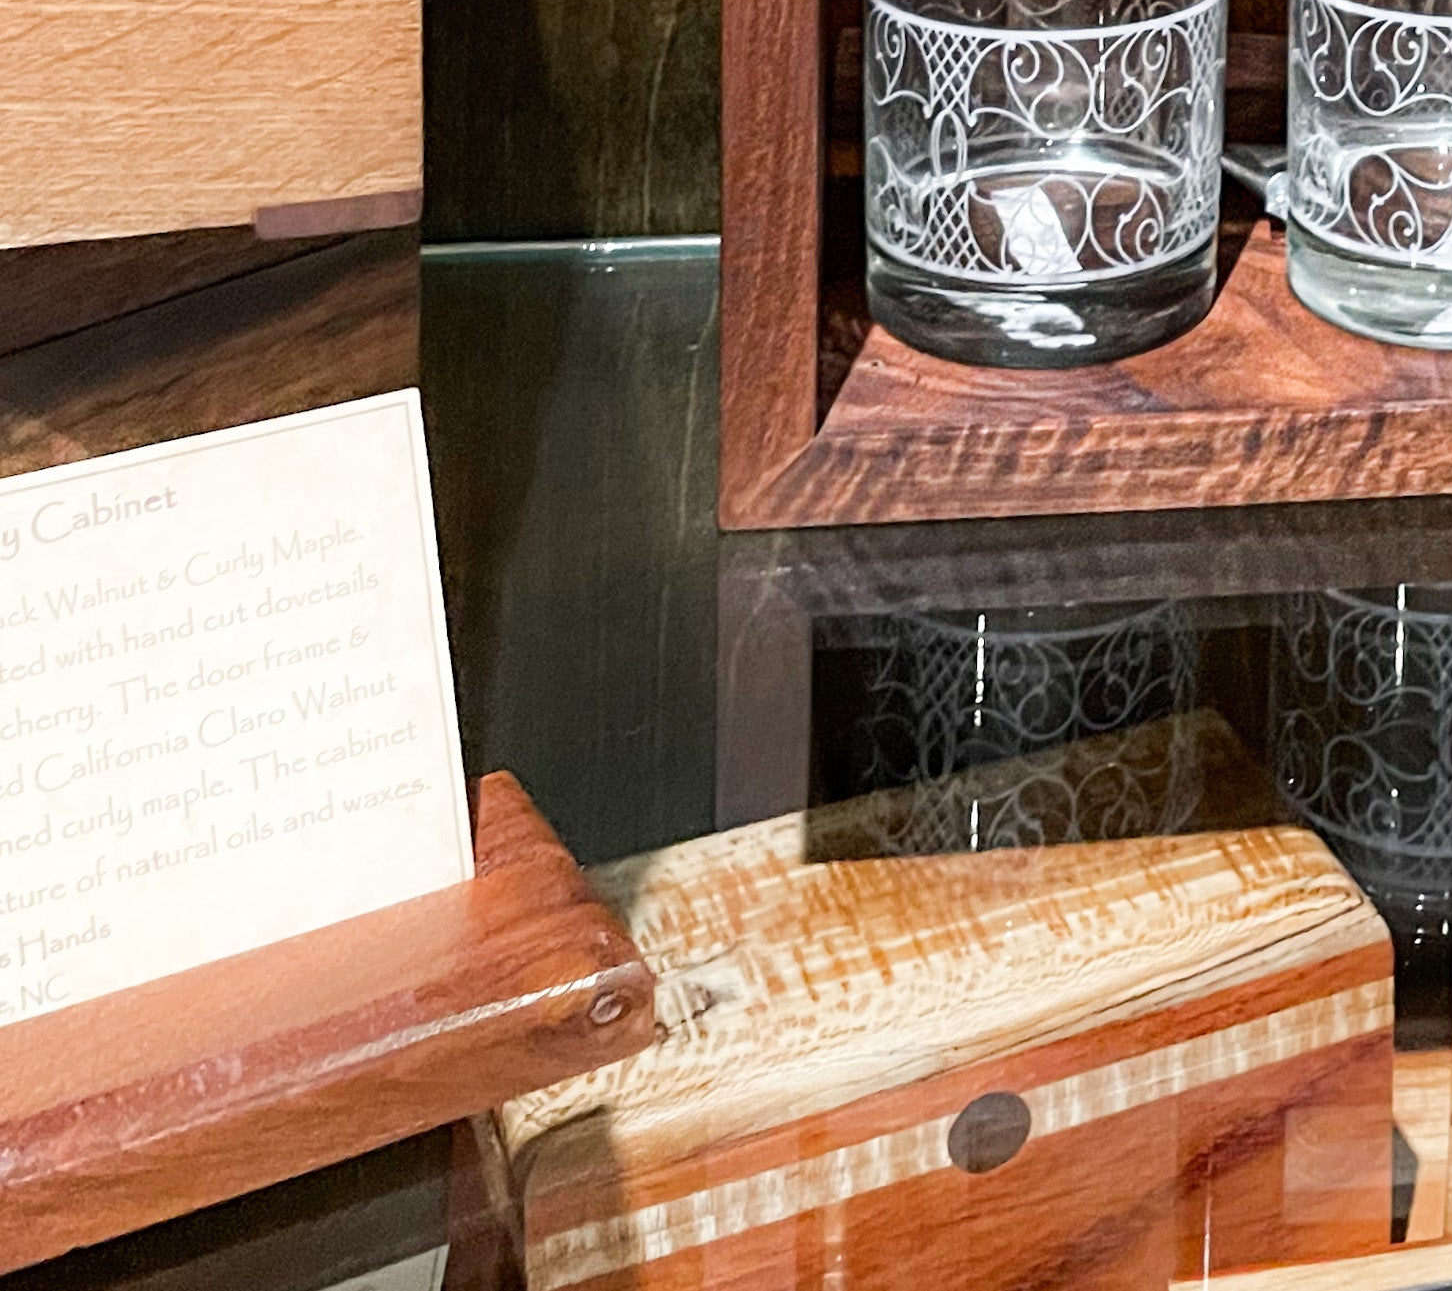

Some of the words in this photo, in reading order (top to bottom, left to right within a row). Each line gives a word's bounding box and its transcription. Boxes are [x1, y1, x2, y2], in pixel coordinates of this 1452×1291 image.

[31, 486, 177, 543] Cabinet
[43, 576, 148, 621] Walnut
[156, 569, 177, 591] &
[184, 542, 264, 586] Curly
[271, 520, 363, 564] Maple.
[55, 629, 114, 669] with
[122, 607, 194, 653] hand
[203, 603, 248, 632] cut
[256, 563, 379, 618] dovetails
[0, 701, 101, 741] cherry.
[108, 674, 179, 715] The
[187, 659, 257, 691] door
[263, 638, 341, 670] frame
[349, 625, 370, 648] &
[34, 730, 189, 793] California
[197, 706, 286, 748] Claro
[291, 672, 397, 721] Walnut
[62, 795, 133, 839] curly
[142, 769, 233, 820] maple.
[238, 750, 307, 791] The
[315, 720, 418, 767] cabinet
[76, 855, 107, 893] of
[116, 824, 217, 881] natural
[226, 812, 274, 849] oils
[283, 790, 334, 833] and
[342, 778, 431, 814] waxes.
[18, 915, 111, 967] Hands
[21, 972, 71, 1010] NC
